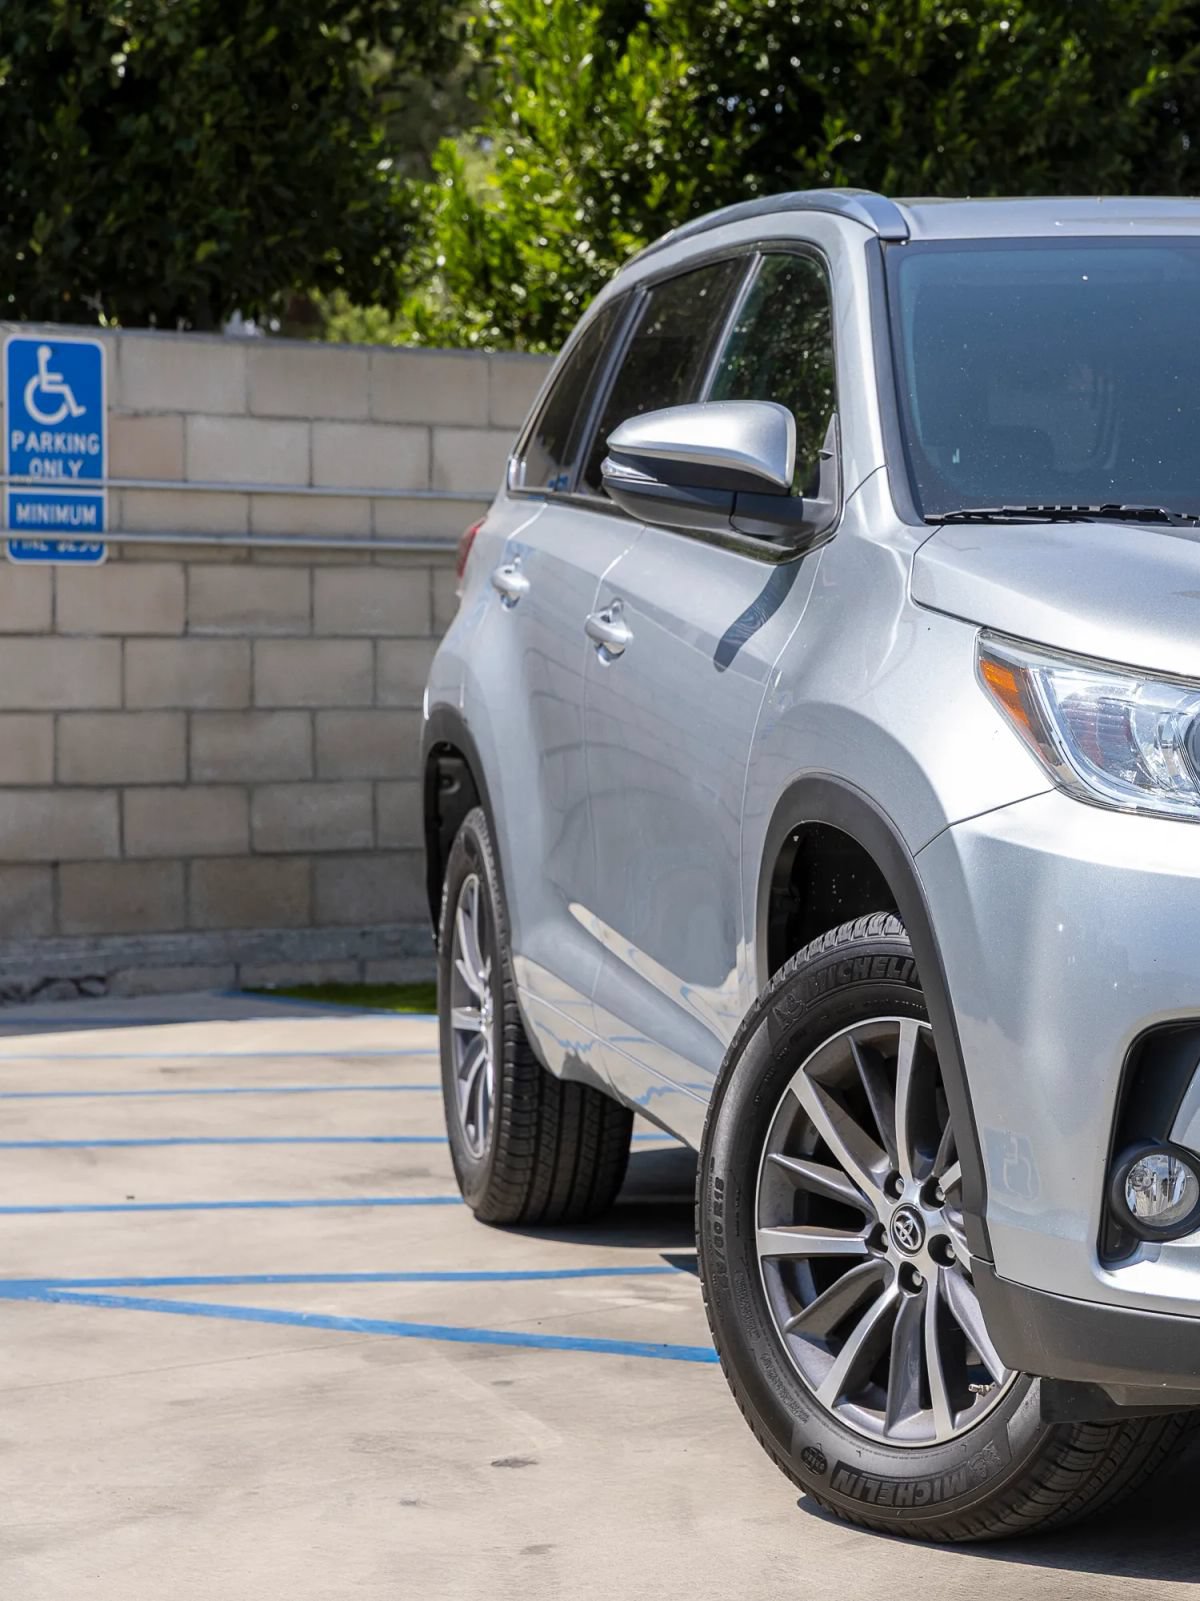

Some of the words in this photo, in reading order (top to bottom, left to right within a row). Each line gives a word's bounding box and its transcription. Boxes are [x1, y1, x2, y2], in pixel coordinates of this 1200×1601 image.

[12, 430, 99, 455] PARKING
[29, 457, 83, 479] ONLY
[16, 503, 96, 525] MINIMUM
[831, 1470, 968, 1507] MICHELIN
